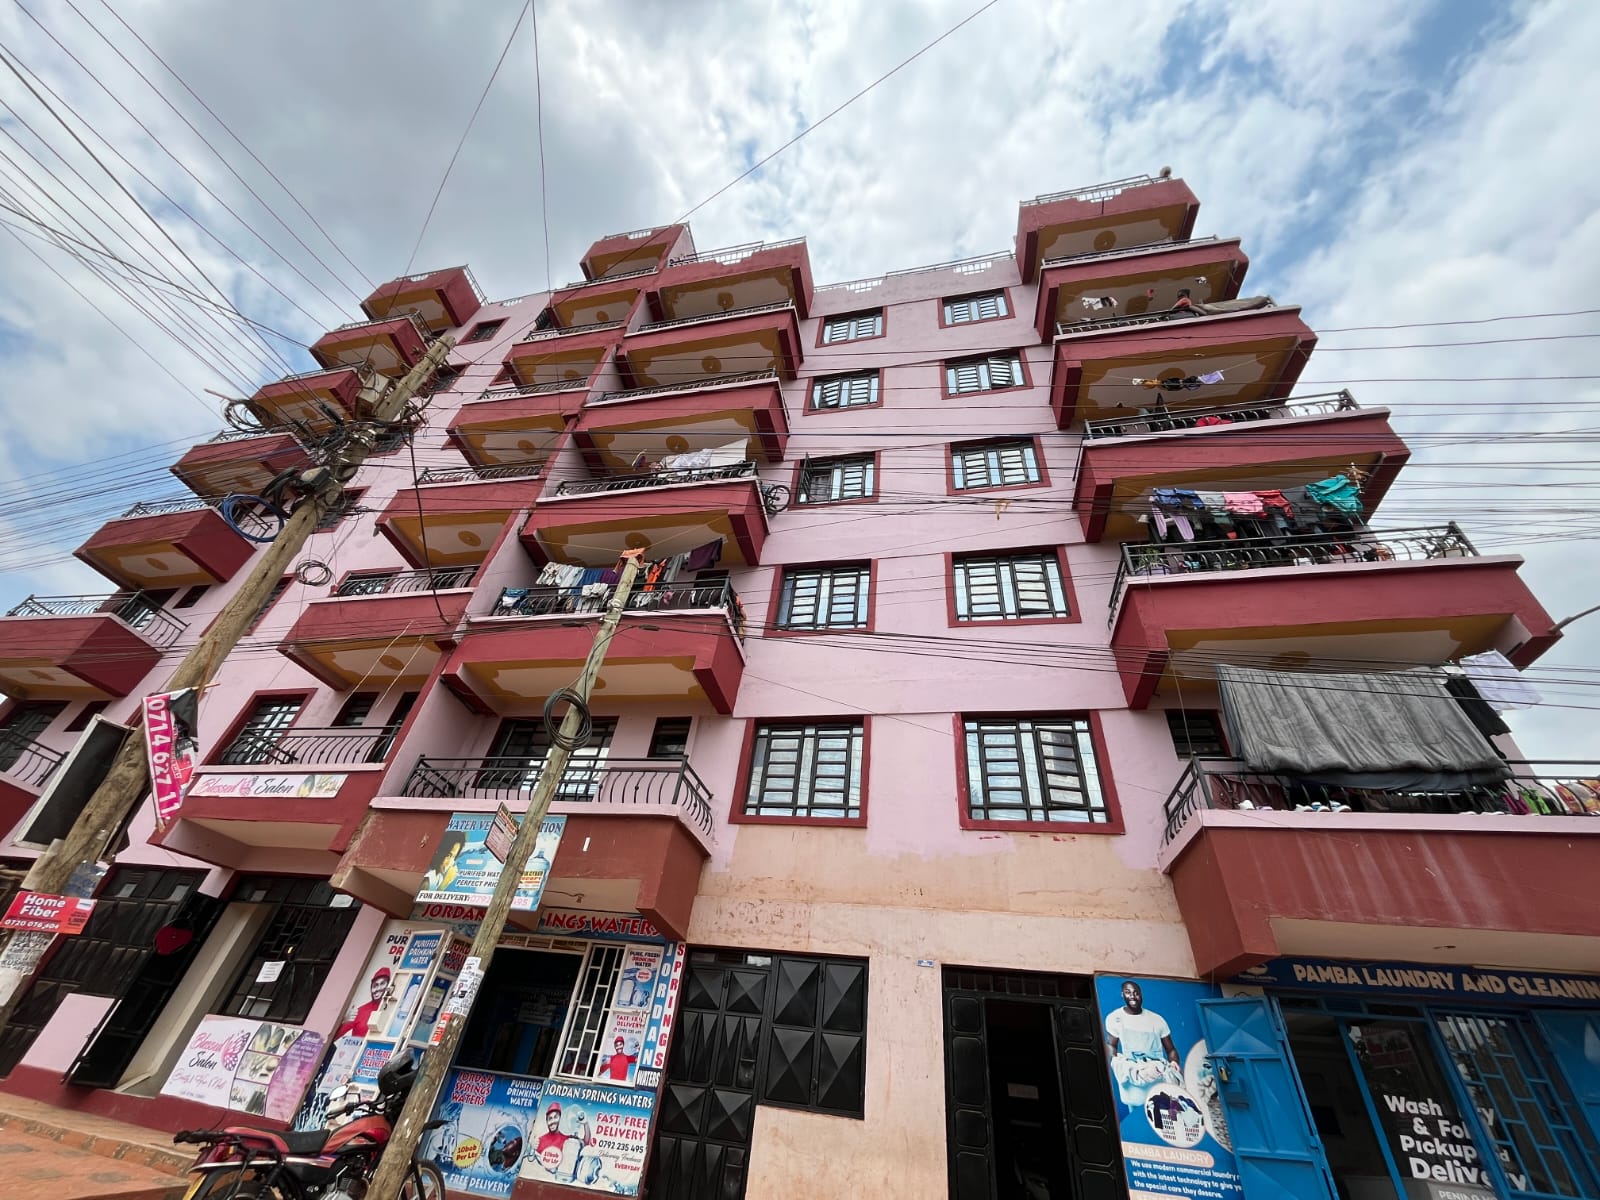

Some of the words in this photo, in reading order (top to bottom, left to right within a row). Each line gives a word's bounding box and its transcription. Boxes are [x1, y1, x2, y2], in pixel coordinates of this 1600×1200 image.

[148, 698, 171, 746] 0714
[254, 777, 294, 795] Salon
[539, 822, 565, 833] TION
[456, 880, 484, 888] PERFECT
[24, 895, 66, 908] Home
[419, 892, 433, 900] FOR
[20, 905, 60, 918] Fiber
[545, 912, 587, 930] INGS
[387, 935, 409, 945] PUR
[1293, 964, 1363, 986] PAMBA
[1362, 967, 1456, 991] LAUNDRY
[1462, 973, 1507, 995] AND
[189, 1051, 218, 1070] Salon
[459, 1071, 495, 1084] JORDAN
[510, 1079, 542, 1090] PURIFIED
[637, 1069, 660, 1088] WATERS
[455, 1081, 491, 1095] SPRINGS
[506, 1087, 541, 1100] DRINKING
[450, 1092, 486, 1107] WATERS
[510, 1097, 533, 1107] WATER
[545, 1083, 580, 1099] JORDAN
[581, 1087, 617, 1104] SPRINGS
[619, 1092, 653, 1109] WATERS
[1383, 1094, 1443, 1117] Wash
[624, 1116, 648, 1129] FREE
[1412, 1117, 1431, 1136] &
[1437, 1119, 1472, 1140] Fol
[596, 1125, 646, 1141] DELIVERY
[598, 1140, 616, 1150] 0792
[616, 1142, 630, 1151] 235
[630, 1144, 644, 1154] 495
[1128, 1144, 1161, 1159] PAMBA
[1162, 1150, 1210, 1165] LAUNDRY
[1400, 1134, 1478, 1163] Pickup
[456, 1153, 467, 1161] Per
[614, 1162, 641, 1172] EVERYDAY
[1130, 1160, 1141, 1168] We
[1153, 1163, 1176, 1172] modern
[1176, 1166, 1211, 1177] commercial
[1212, 1170, 1237, 1181] laundry
[449, 1173, 469, 1185] FREE
[469, 1177, 510, 1193] DELIVERY
[1133, 1170, 1147, 1178] with
[1158, 1174, 1176, 1183] latest
[1177, 1176, 1211, 1188] technology
[1220, 1182, 1233, 1191] give
[1134, 1180, 1145, 1188] the
[1146, 1182, 1167, 1192] special
[1168, 1185, 1182, 1193] care
[1182, 1187, 1197, 1197] they
